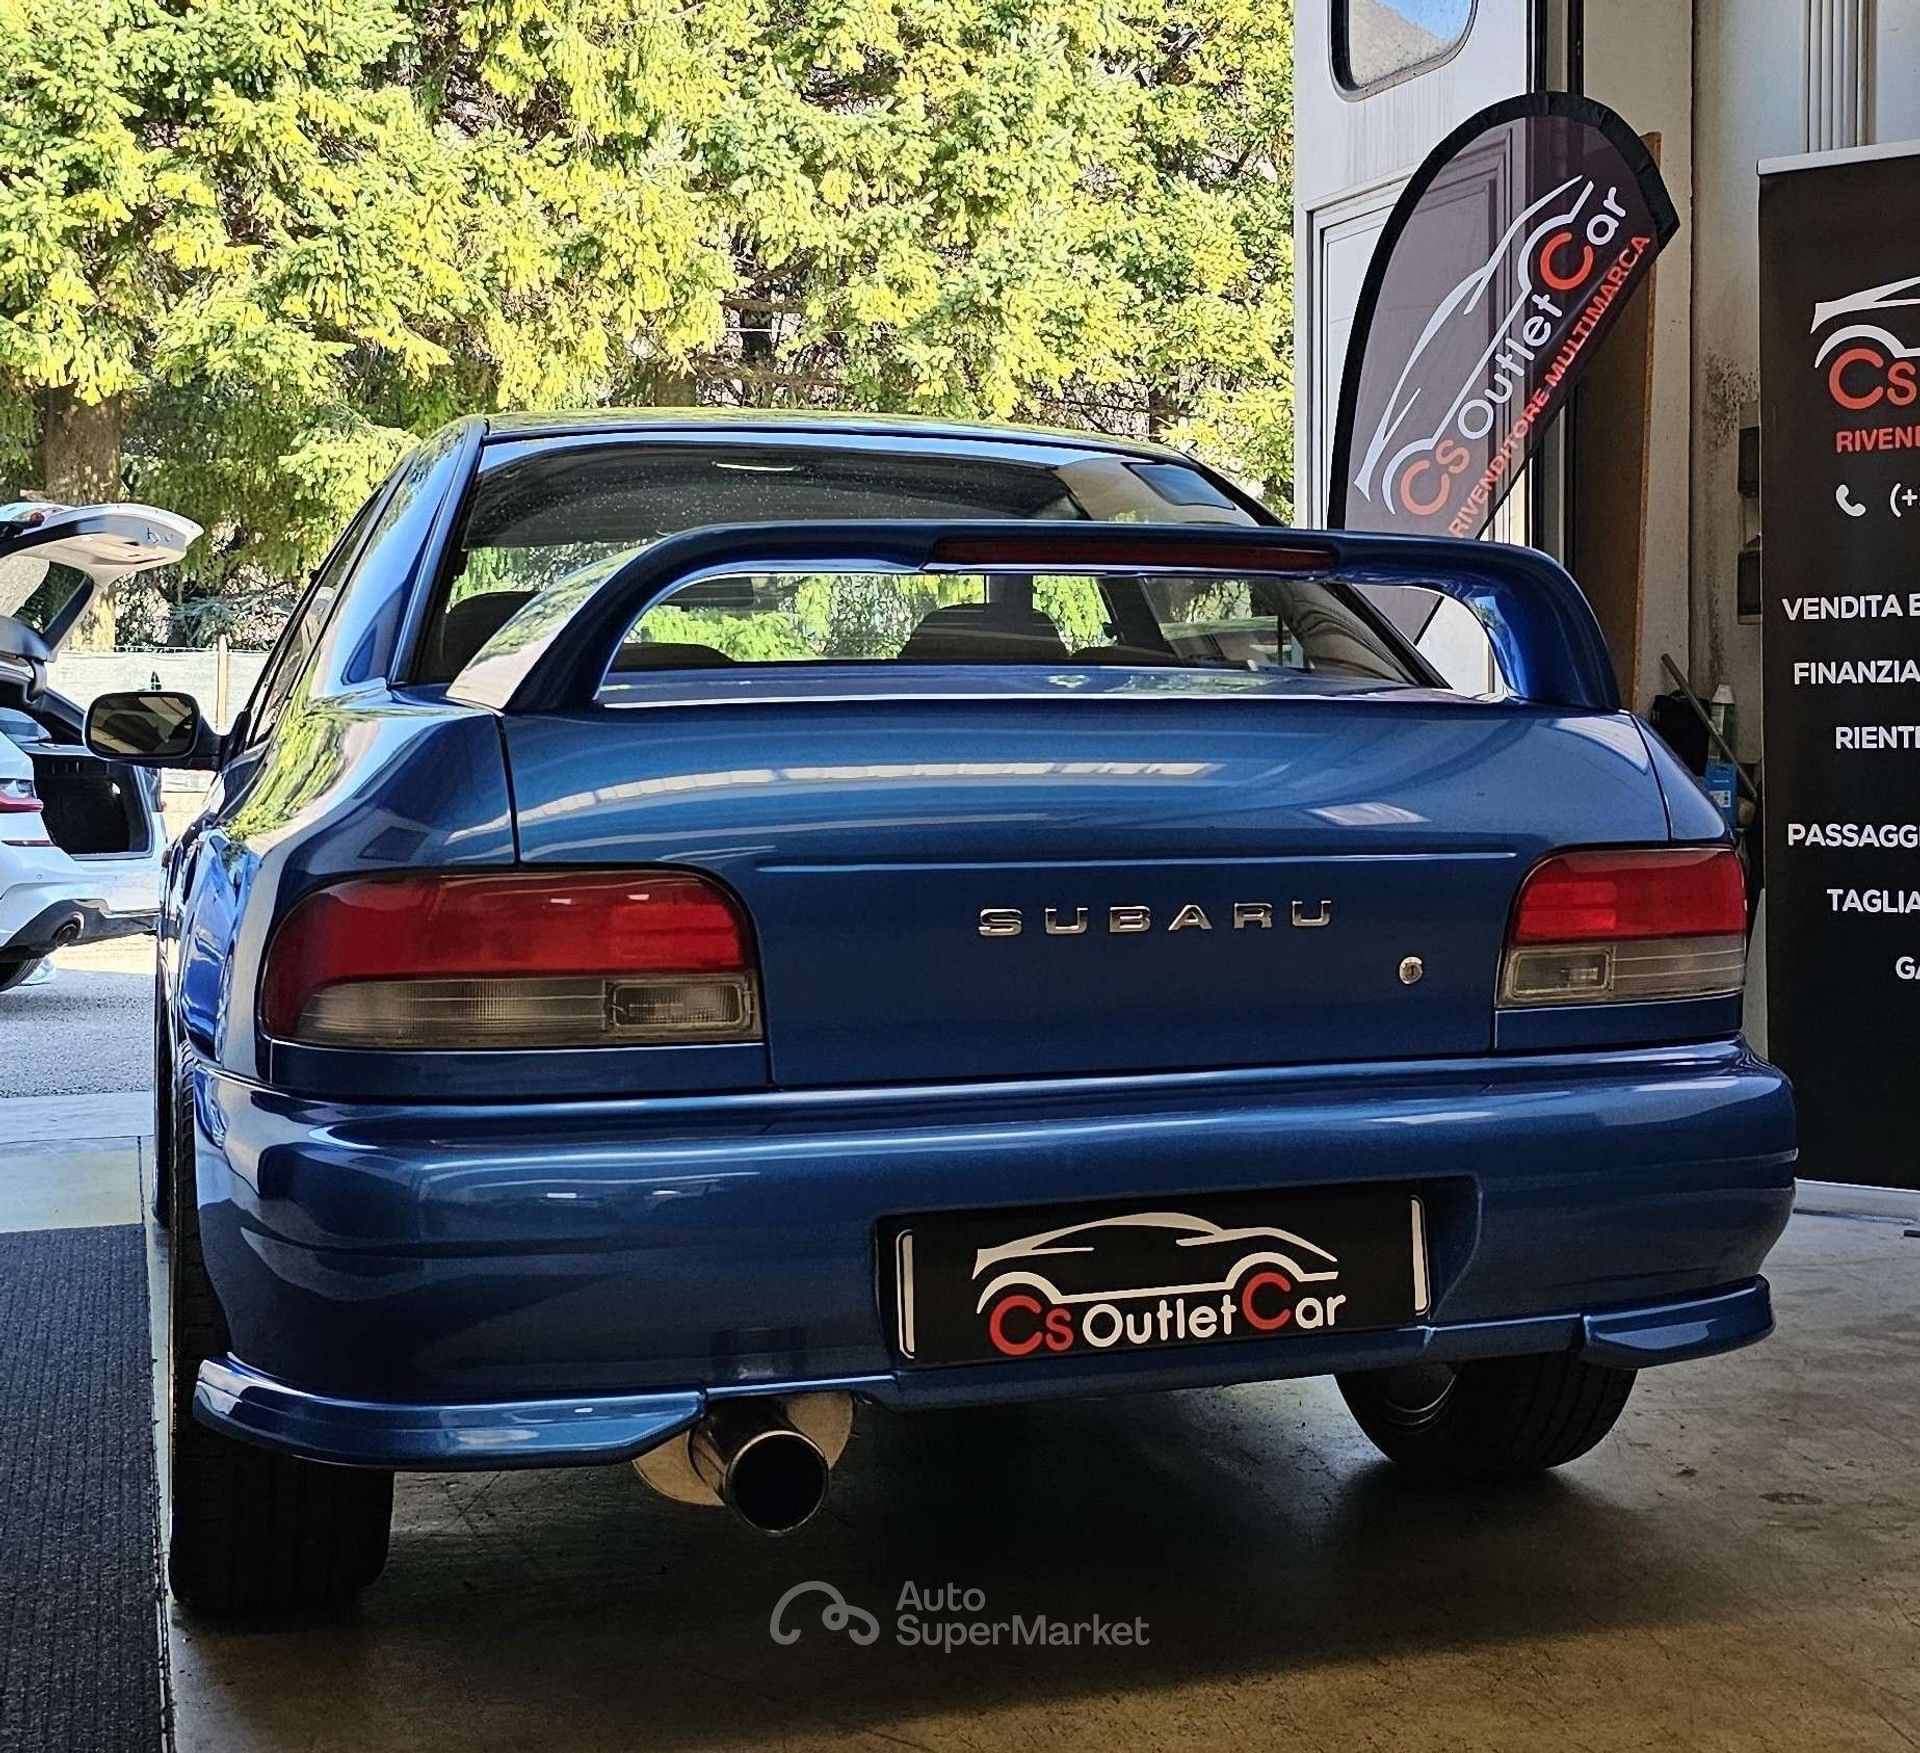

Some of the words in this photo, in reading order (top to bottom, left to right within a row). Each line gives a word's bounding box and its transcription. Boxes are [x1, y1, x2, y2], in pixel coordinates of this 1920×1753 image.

[1448, 387, 1551, 539] RIVENDITORE
[1544, 233, 1651, 388] MULTIMARCA
[1782, 594, 1903, 622] VENDITA
[978, 900, 1332, 936] SUBARU
[1895, 956, 1920, 980] G
